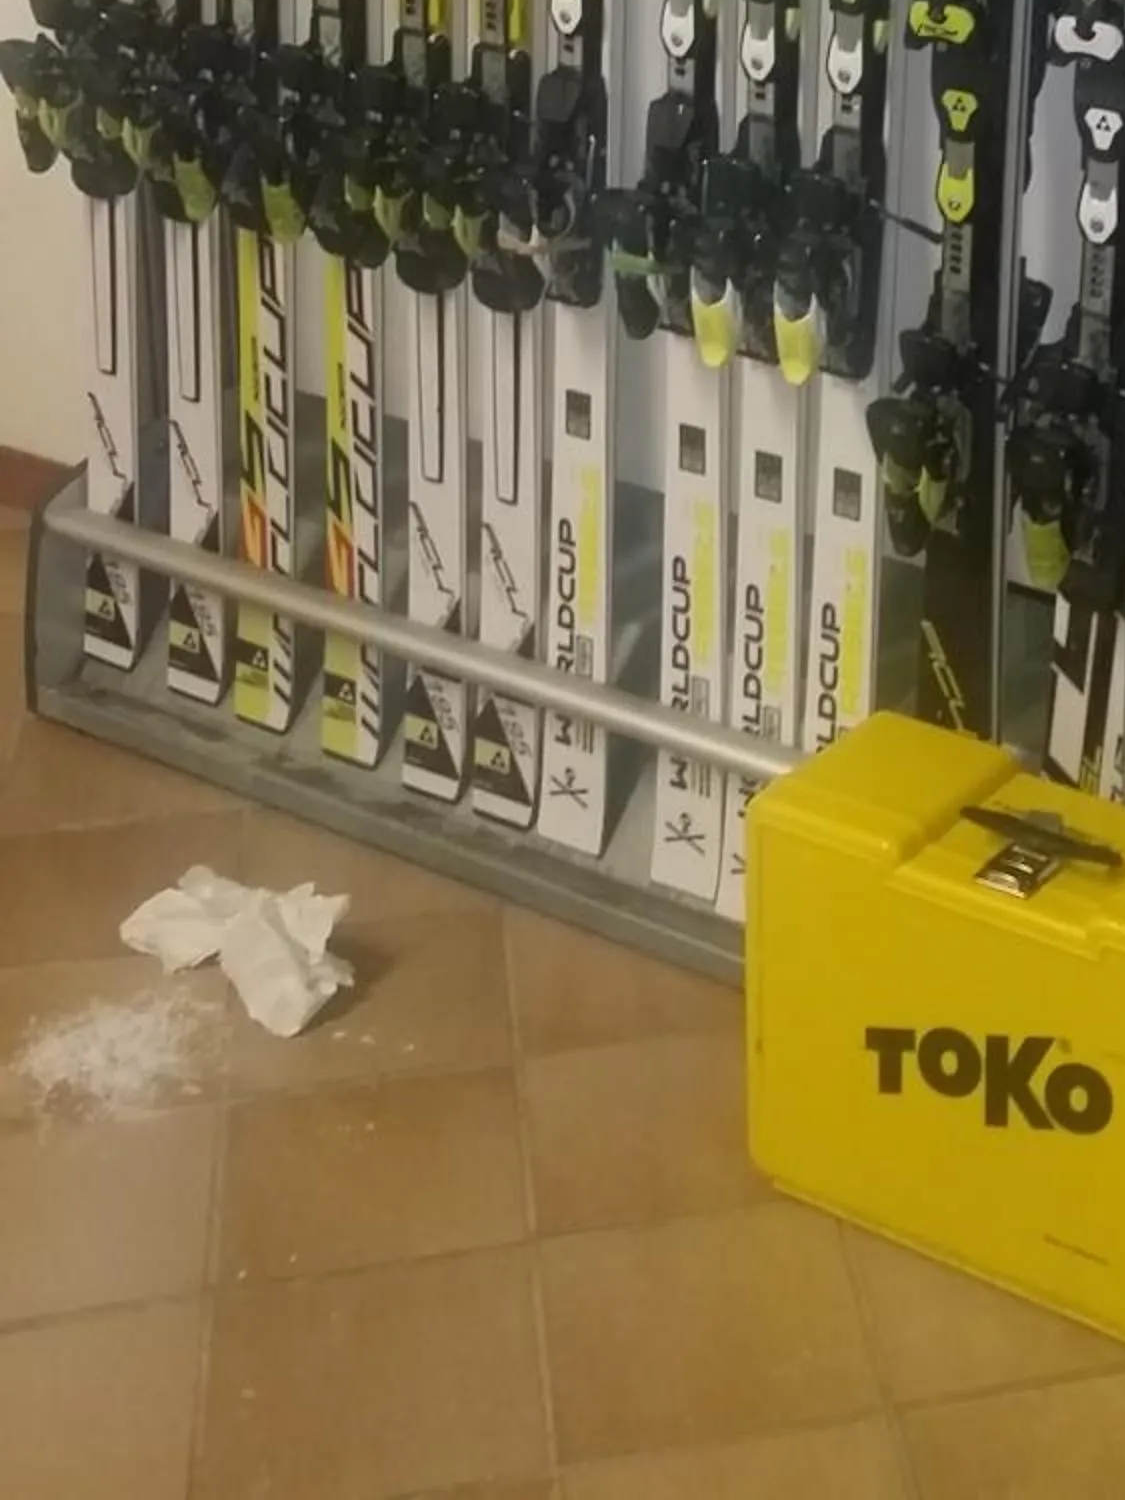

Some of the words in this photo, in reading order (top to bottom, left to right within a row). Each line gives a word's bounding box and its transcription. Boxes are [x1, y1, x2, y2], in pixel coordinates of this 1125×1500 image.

[256, 233, 293, 705] WLDCUP
[344, 257, 380, 740] WLDCUP
[555, 518, 577, 746] WRLDCUP
[669, 556, 693, 790] WRLDCUP
[816, 603, 841, 754] LDCUP
[865, 1026, 1114, 1136] TOKO
